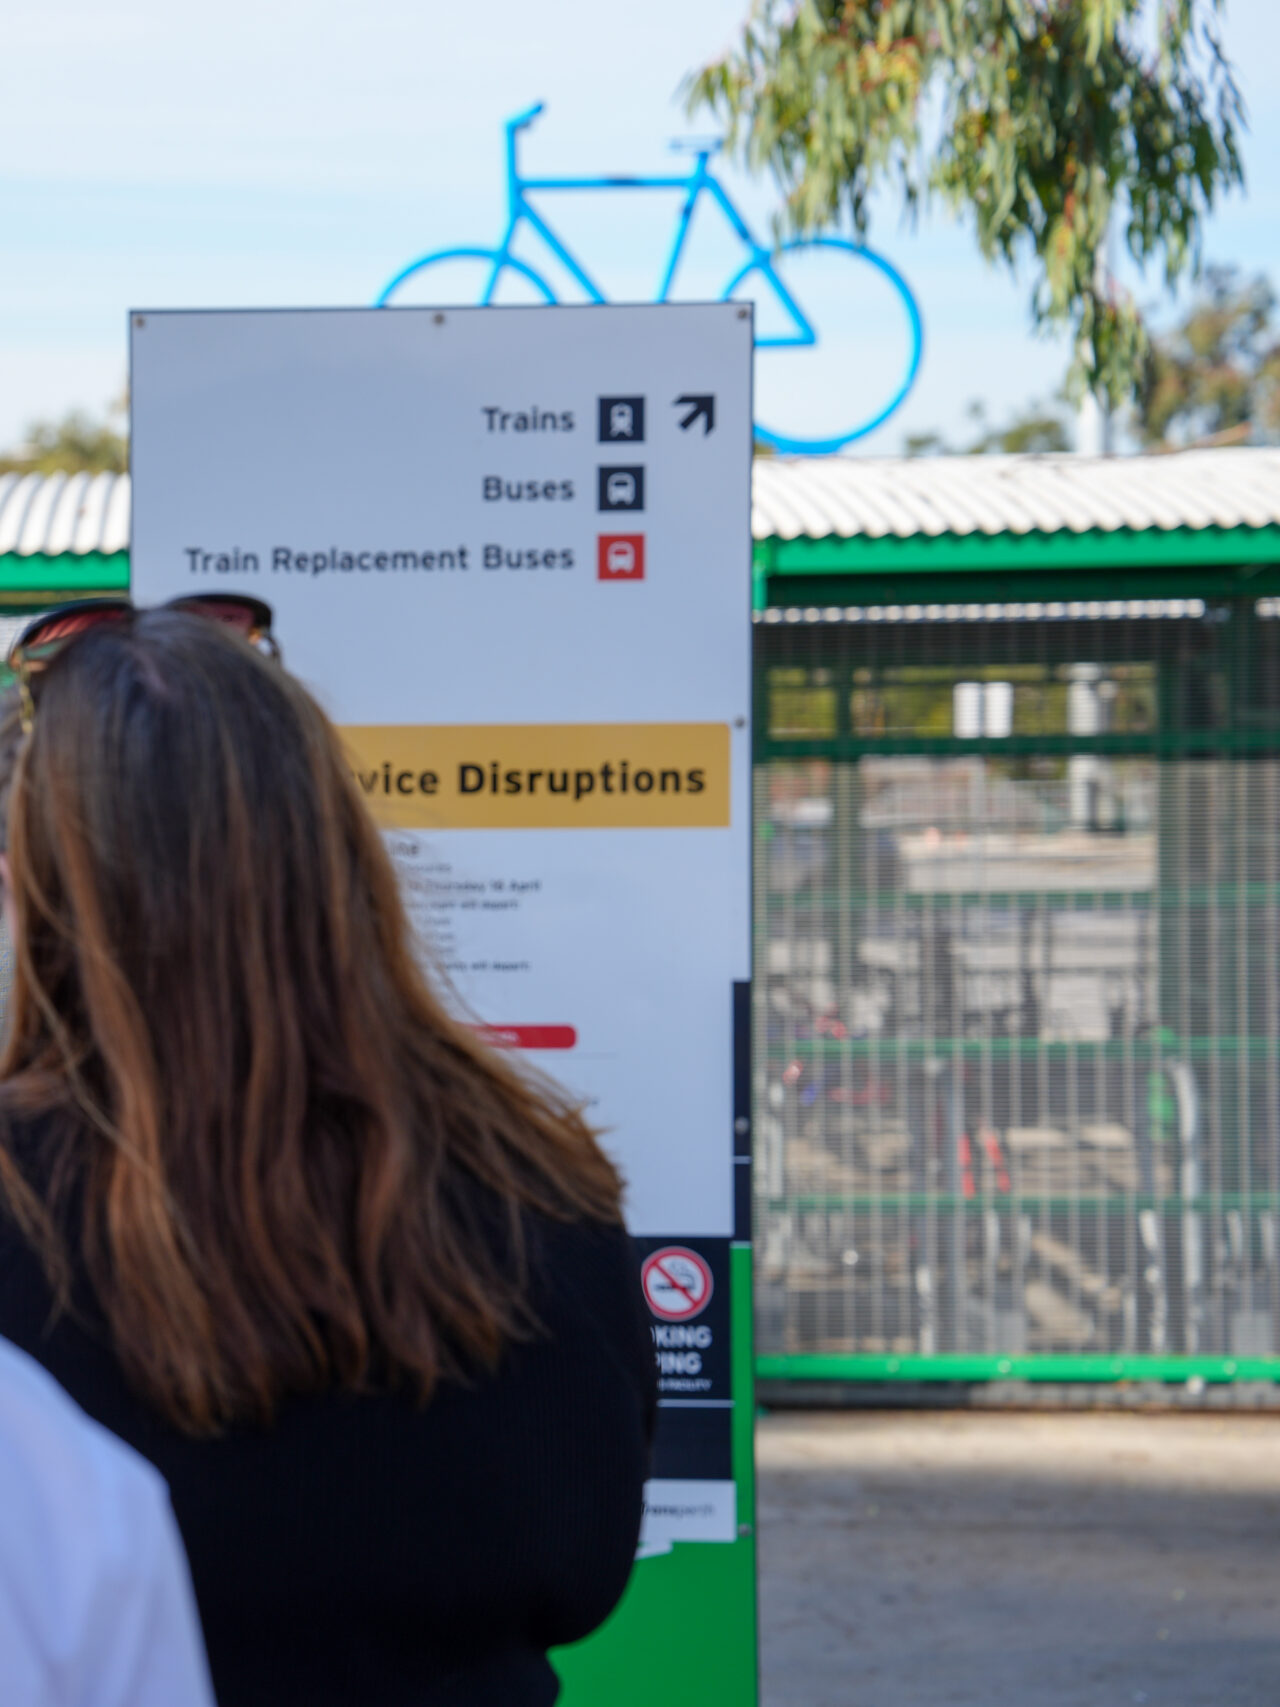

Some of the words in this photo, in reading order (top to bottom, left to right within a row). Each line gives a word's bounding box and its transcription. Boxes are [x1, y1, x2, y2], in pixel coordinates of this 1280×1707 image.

[482, 406, 575, 433] Trains
[483, 475, 575, 503] Buses
[184, 547, 260, 575] Train
[272, 544, 469, 577] Replacement
[483, 544, 575, 571] Buses
[353, 762, 440, 795] vice
[457, 760, 706, 801] Disruptions
[651, 1325, 713, 1349] KING
